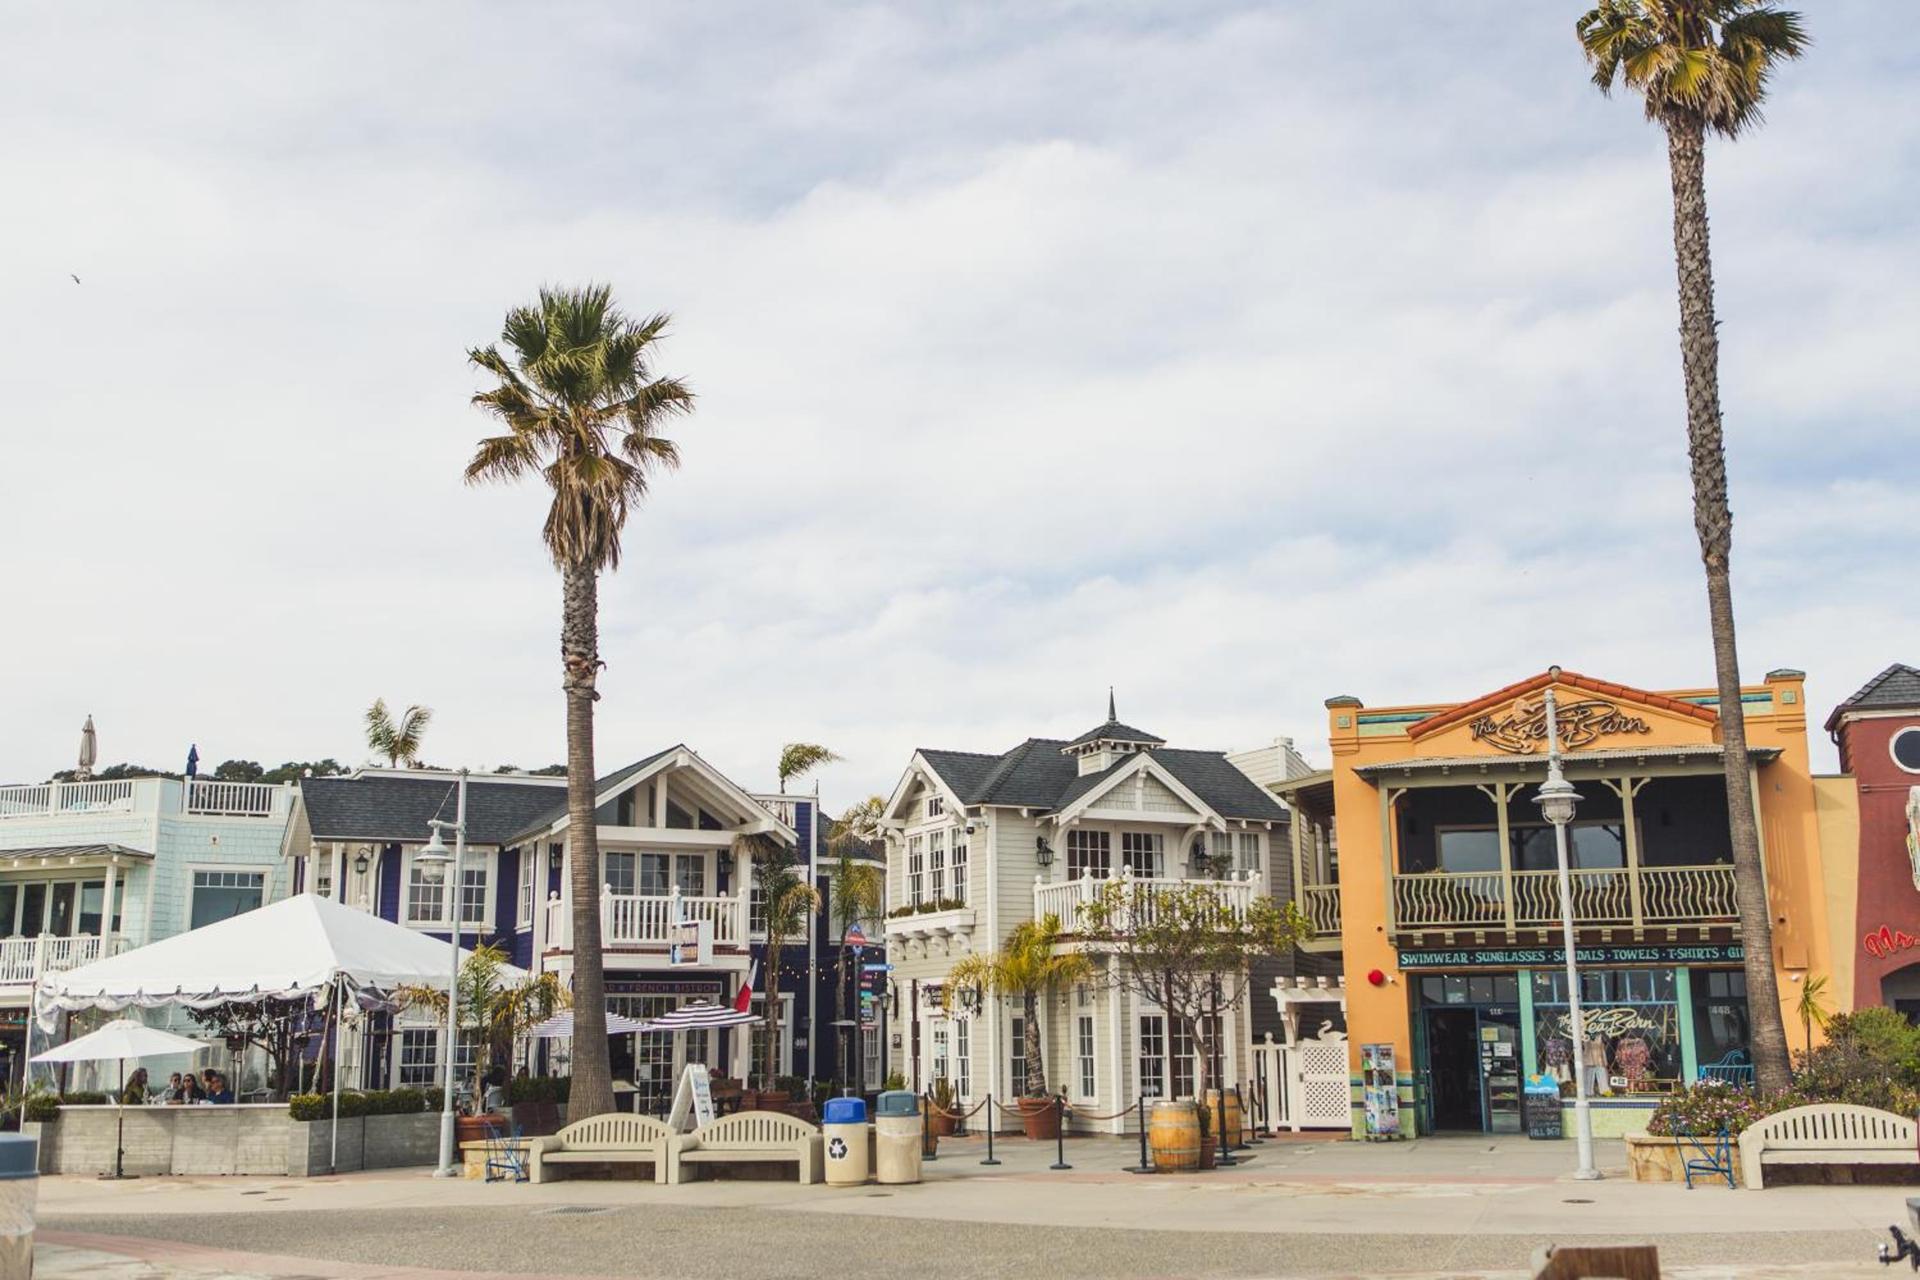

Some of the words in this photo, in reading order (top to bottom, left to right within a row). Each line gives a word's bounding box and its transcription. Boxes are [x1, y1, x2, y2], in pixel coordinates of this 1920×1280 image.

[1558, 700, 1651, 749] Barn
[1401, 952, 1469, 965] SWIMWEAR
[1475, 950, 1546, 963] SUNGLASSES
[1553, 949, 1605, 961] SADALS
[1612, 948, 1659, 961] TOWELS
[1669, 947, 1719, 960] T-SHIRTS
[1598, 1008, 1656, 1039] Barn
